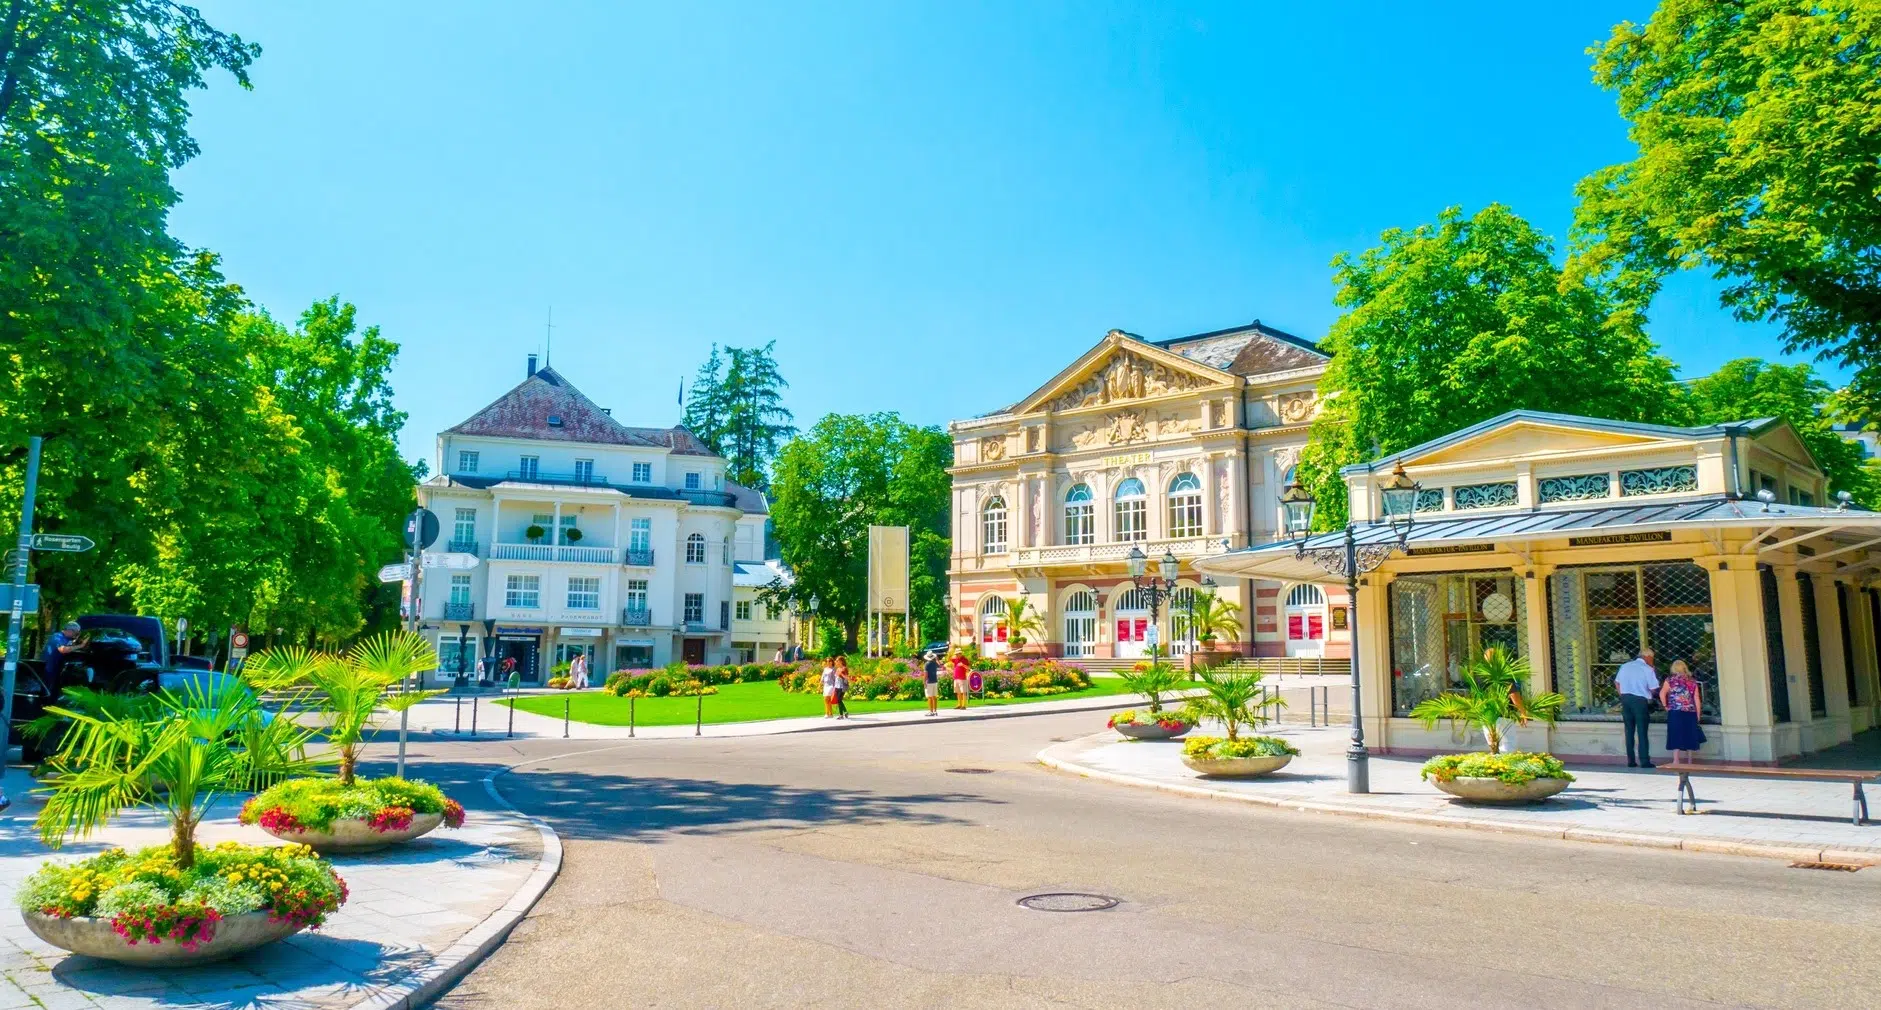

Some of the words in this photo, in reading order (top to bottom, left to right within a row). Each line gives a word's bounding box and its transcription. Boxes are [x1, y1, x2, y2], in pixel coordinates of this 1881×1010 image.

[1104, 453, 1151, 466] THEATER
[1576, 532, 1664, 545] MANUFAKTUR-PAVILLON
[1412, 543, 1488, 554] MANUFAKTUR-PAVILLON
